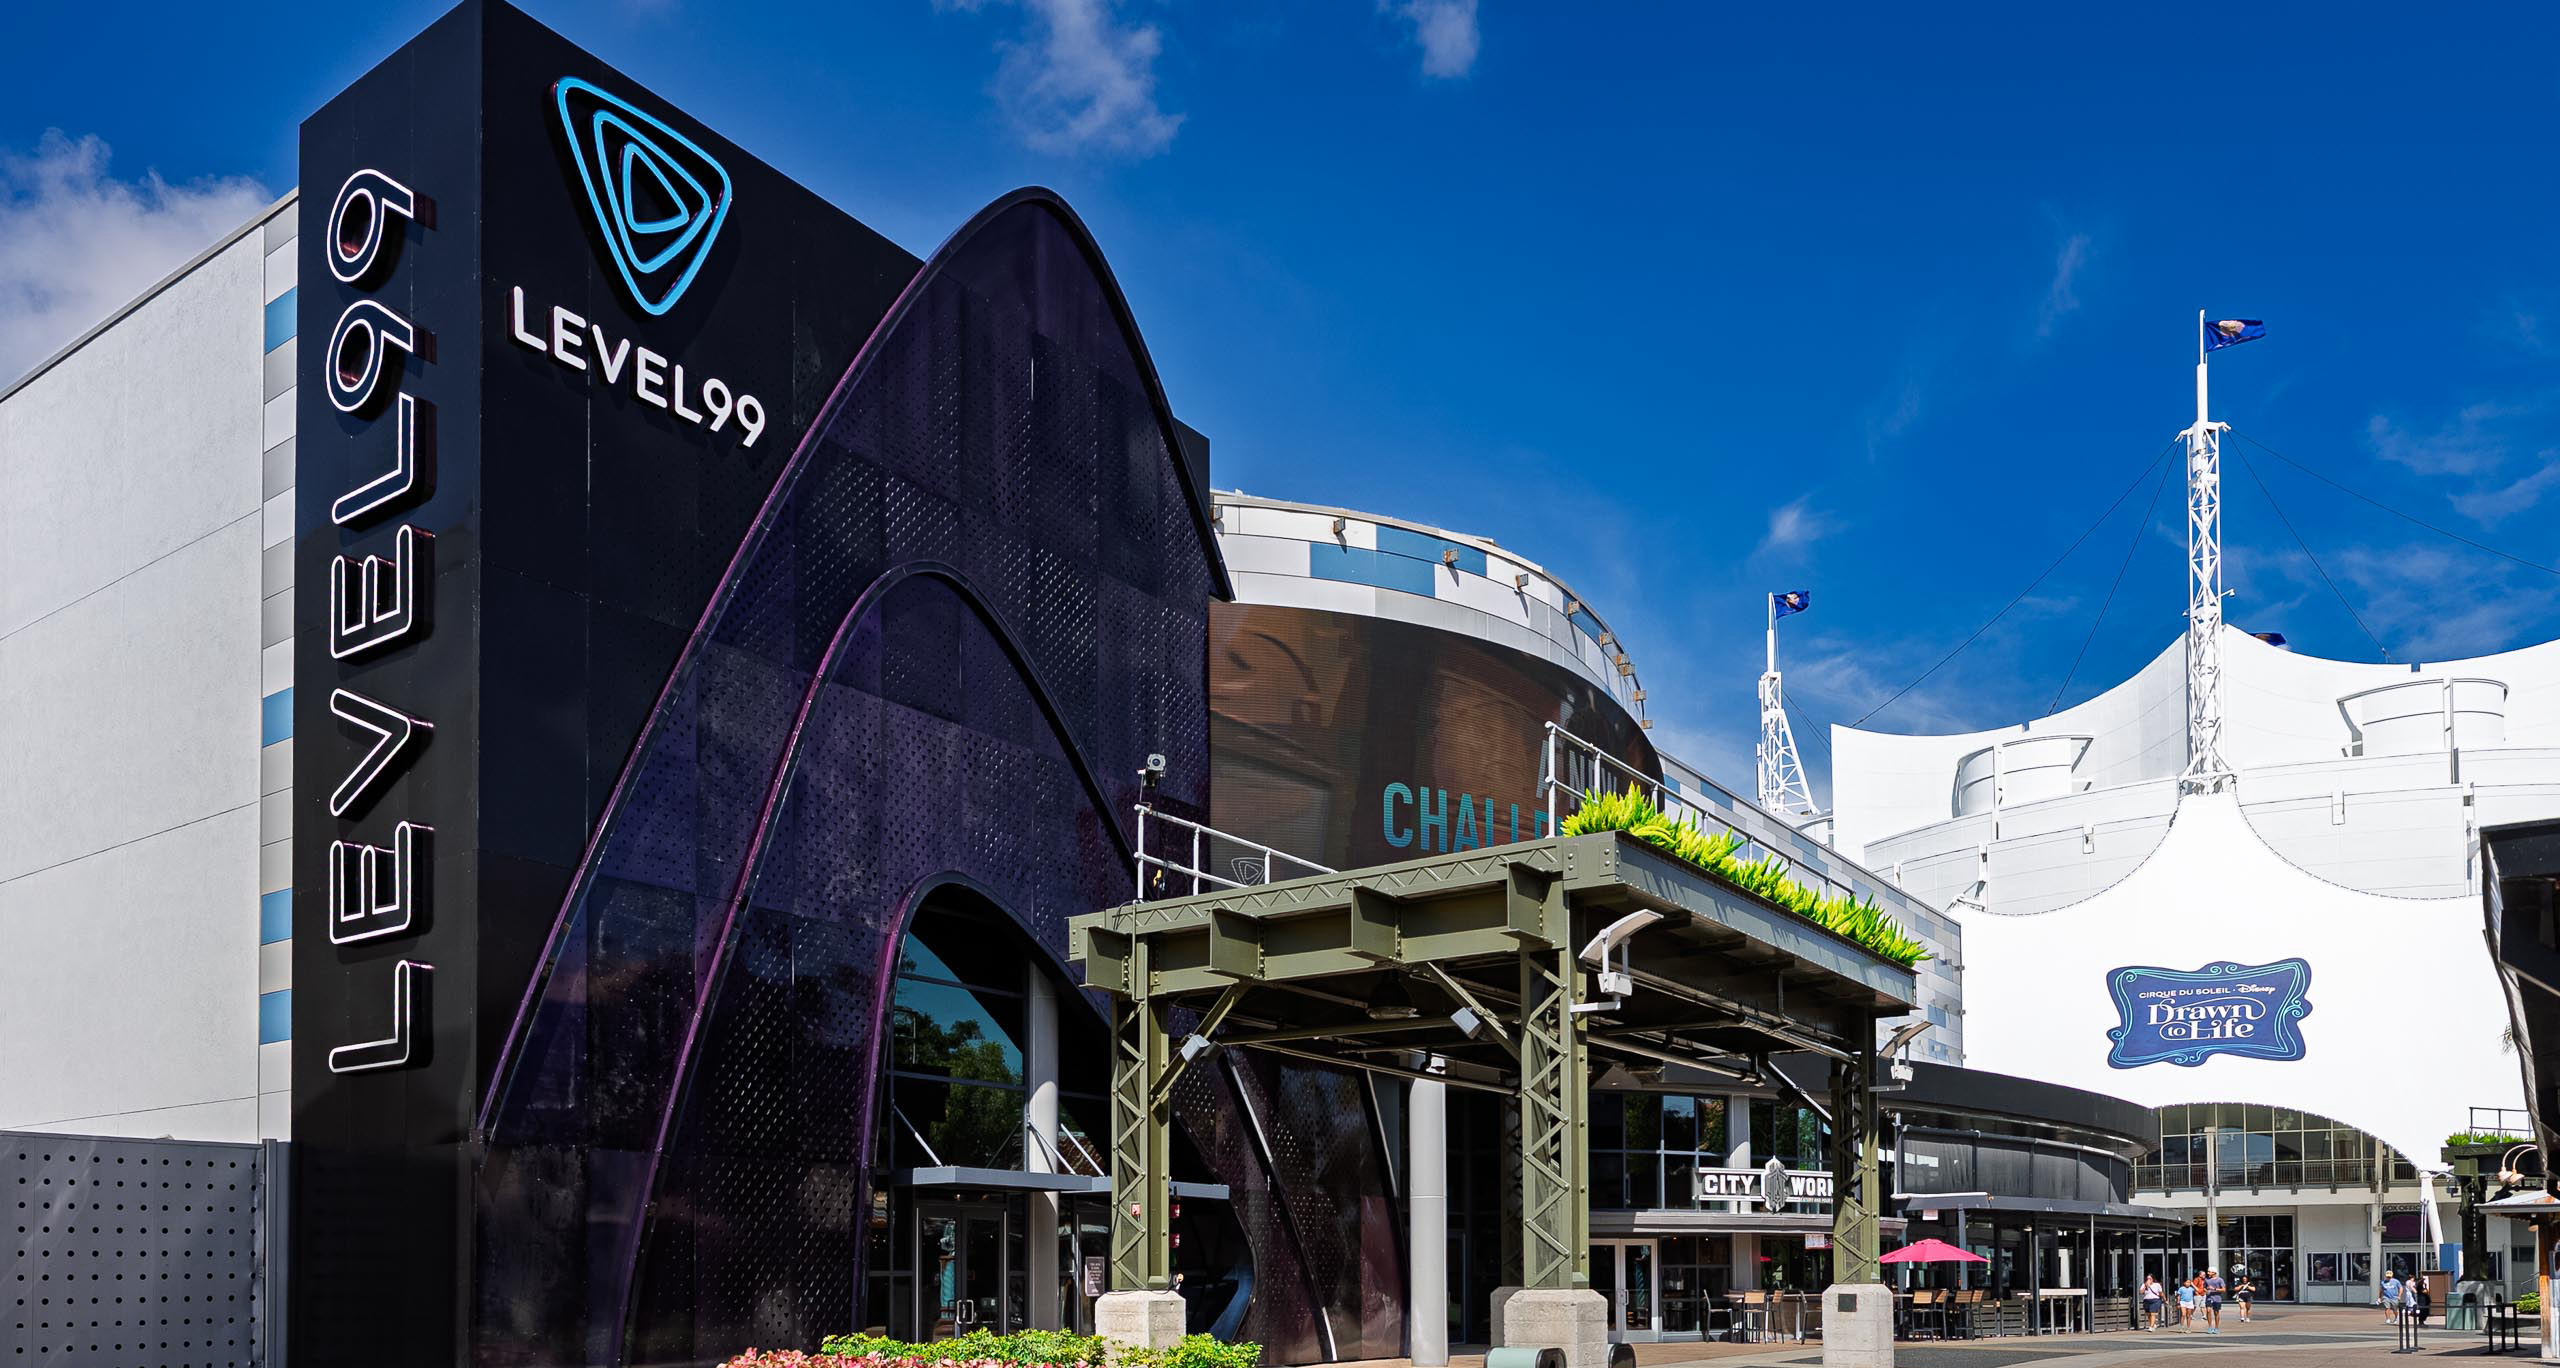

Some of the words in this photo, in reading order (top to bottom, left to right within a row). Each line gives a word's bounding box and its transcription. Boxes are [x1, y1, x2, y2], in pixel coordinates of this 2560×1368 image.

[513, 285, 766, 448] LEVEL99
[326, 168, 415, 1075] LEVEL99
[2139, 990, 2177, 999] CIRQUE
[2196, 987, 2231, 995] SOLEIL
[2236, 983, 2276, 995] Disney
[2147, 997, 2266, 1025] Drawn
[2167, 1026, 2186, 1037] to
[2188, 1018, 2255, 1040] Life
[1704, 1174, 1755, 1195] CITY
